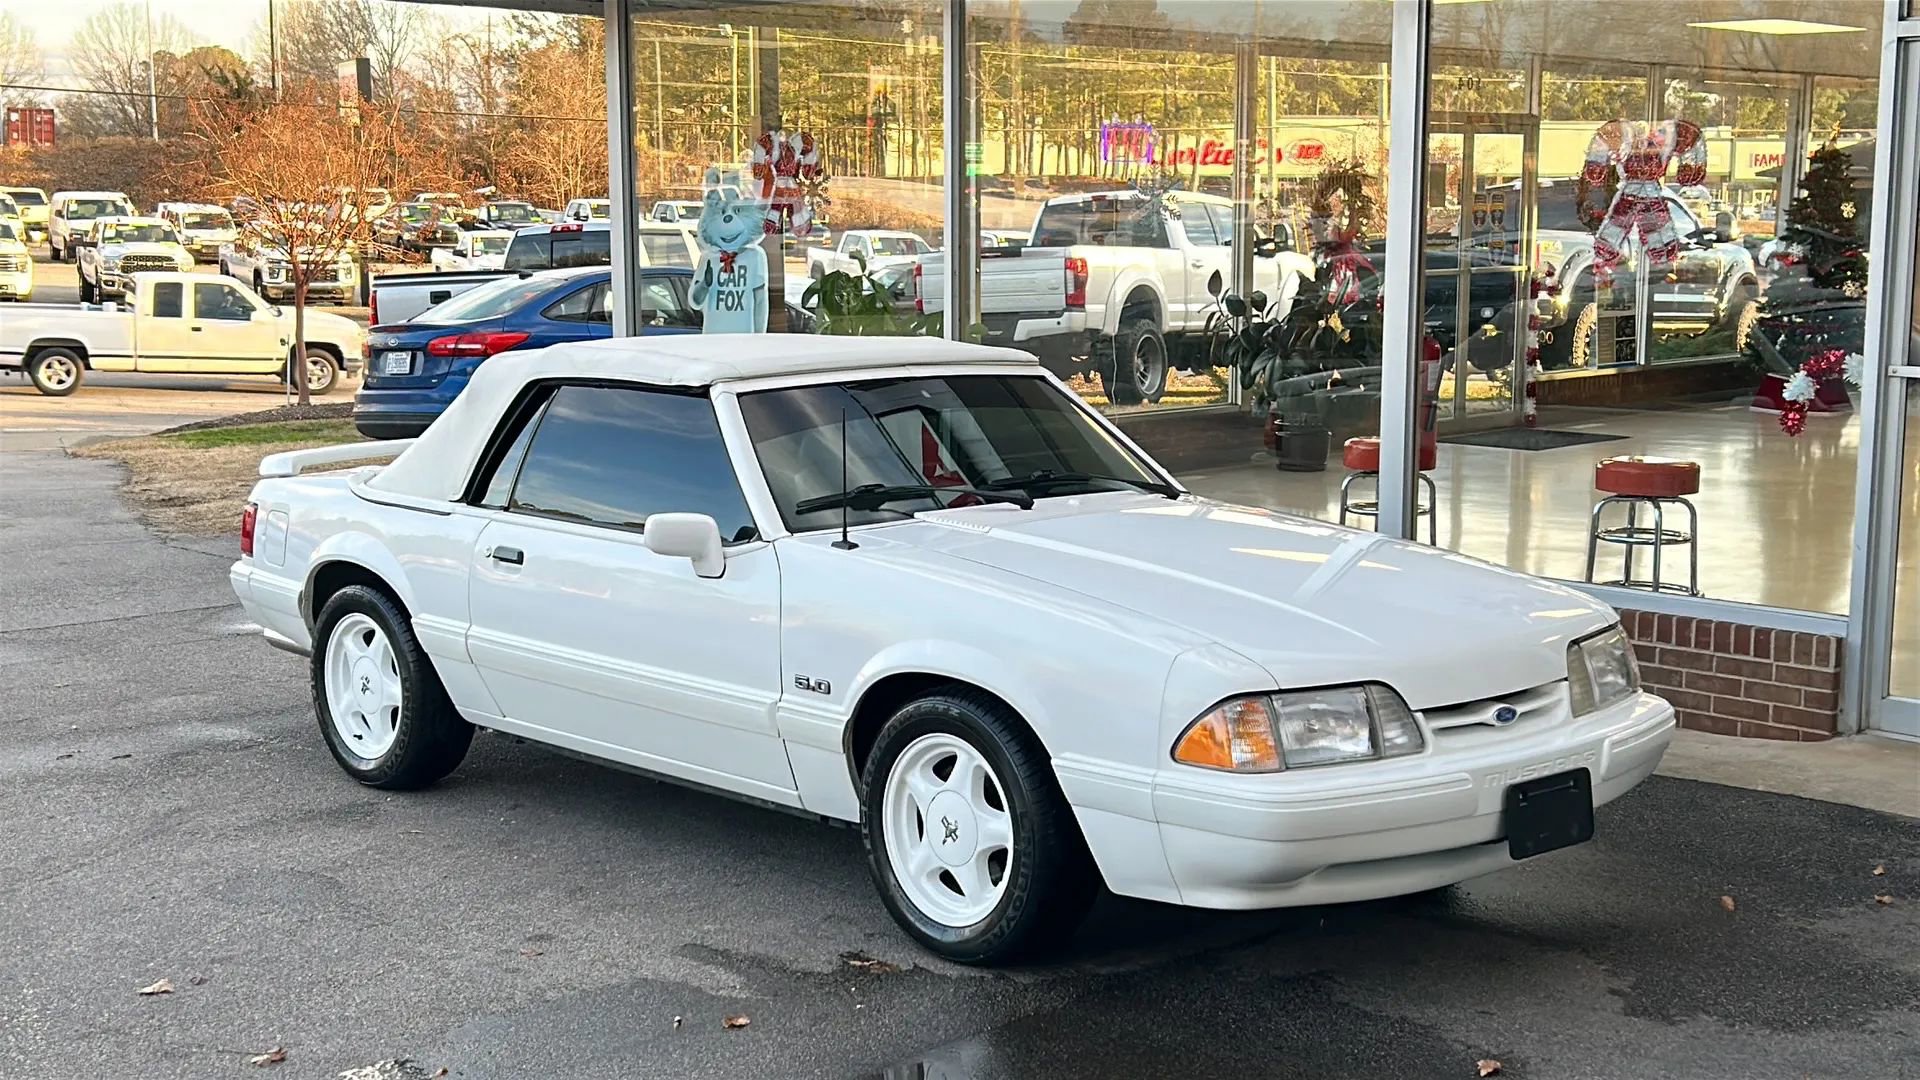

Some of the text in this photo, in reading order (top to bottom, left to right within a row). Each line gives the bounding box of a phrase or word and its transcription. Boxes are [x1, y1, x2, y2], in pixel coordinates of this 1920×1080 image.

[717, 265, 747, 288] CAR
[716, 290, 745, 312] FOX
[794, 674, 831, 695] 5.0
[1485, 751, 1595, 787] MUSTANG
